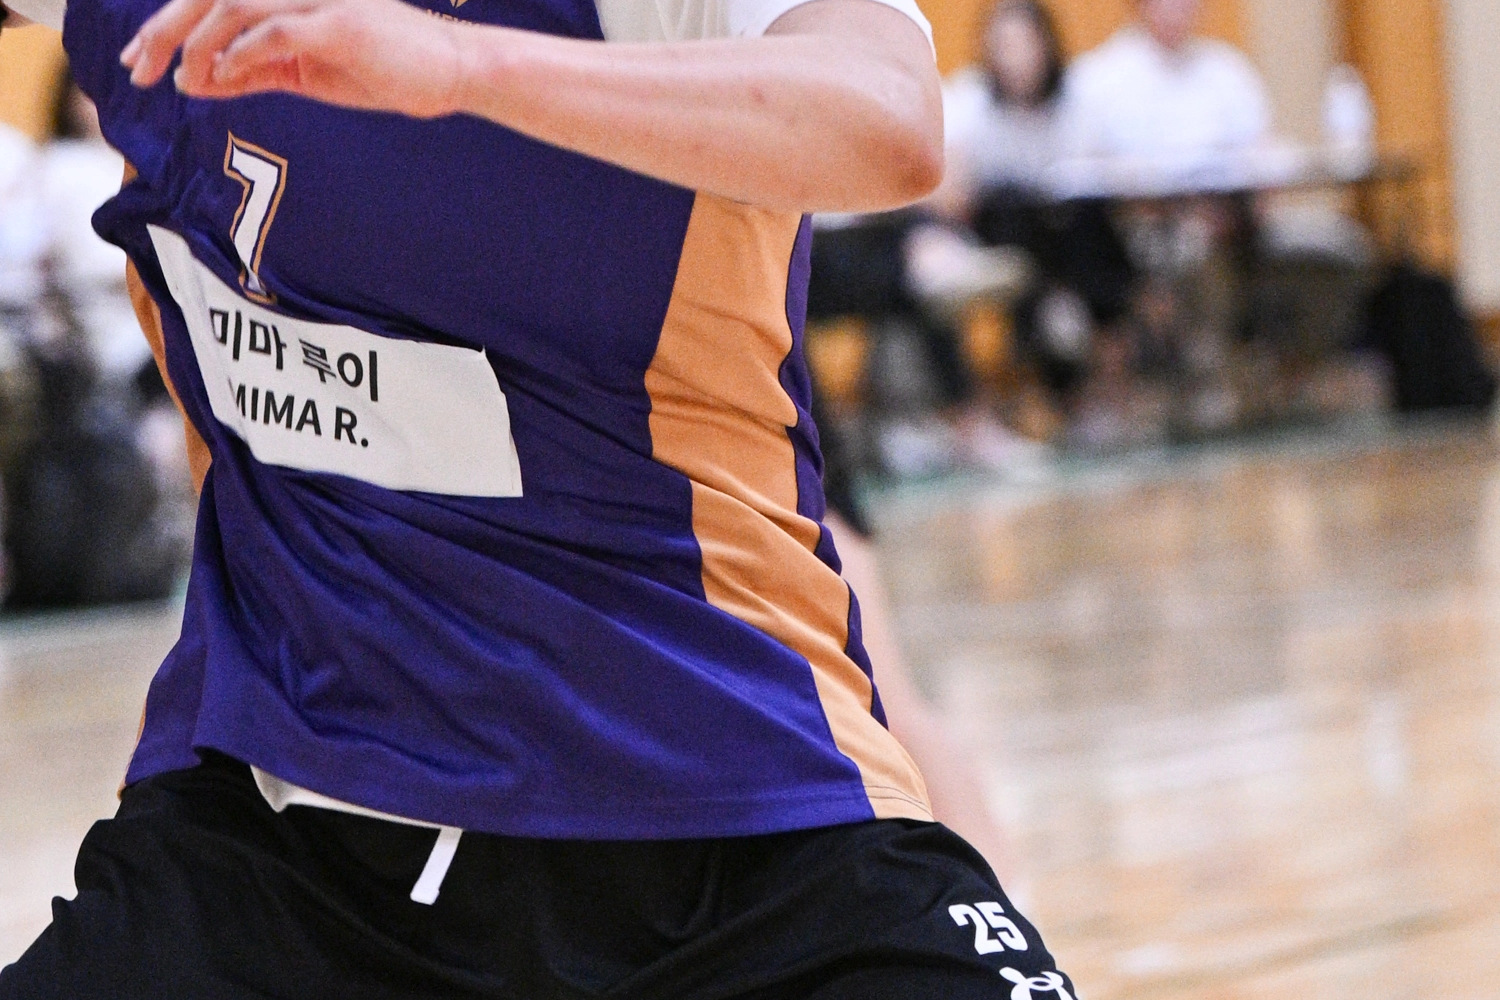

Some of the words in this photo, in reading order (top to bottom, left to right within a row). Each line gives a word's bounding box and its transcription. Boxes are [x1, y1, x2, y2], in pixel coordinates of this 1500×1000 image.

[223, 130, 288, 303] 7
[209, 308, 287, 370] 미마
[299, 338, 380, 401] 루이
[334, 408, 370, 448] R.
[949, 902, 1028, 955] 25
